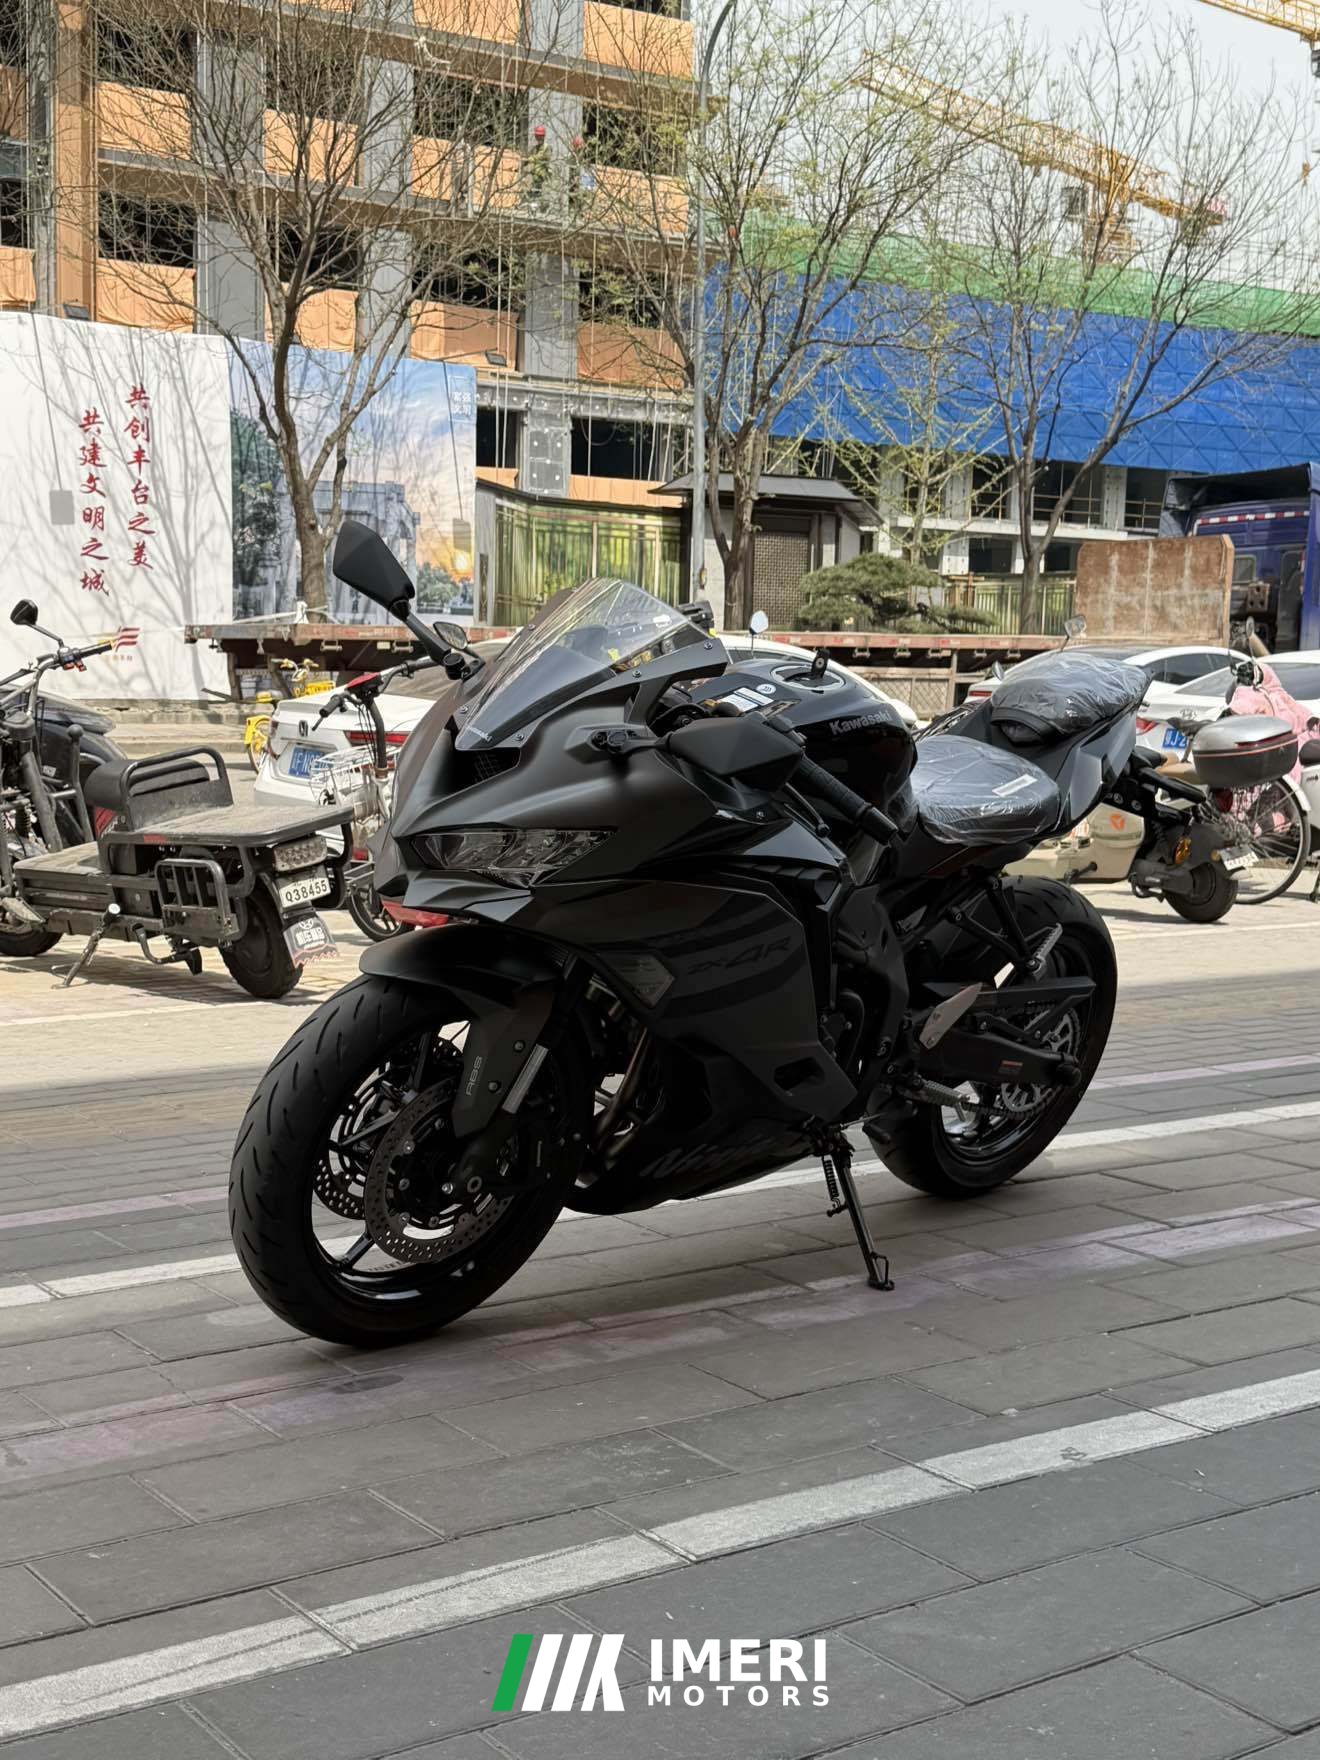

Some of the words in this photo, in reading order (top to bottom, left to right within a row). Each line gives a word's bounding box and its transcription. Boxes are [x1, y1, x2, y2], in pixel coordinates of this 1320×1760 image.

[125, 382, 156, 570] 共创丰台之美
[78, 406, 110, 596] 共建文明之城
[829, 711, 893, 735] Kawasaki
[285, 879, 328, 902] Q38455
[465, 1056, 482, 1096] ABS
